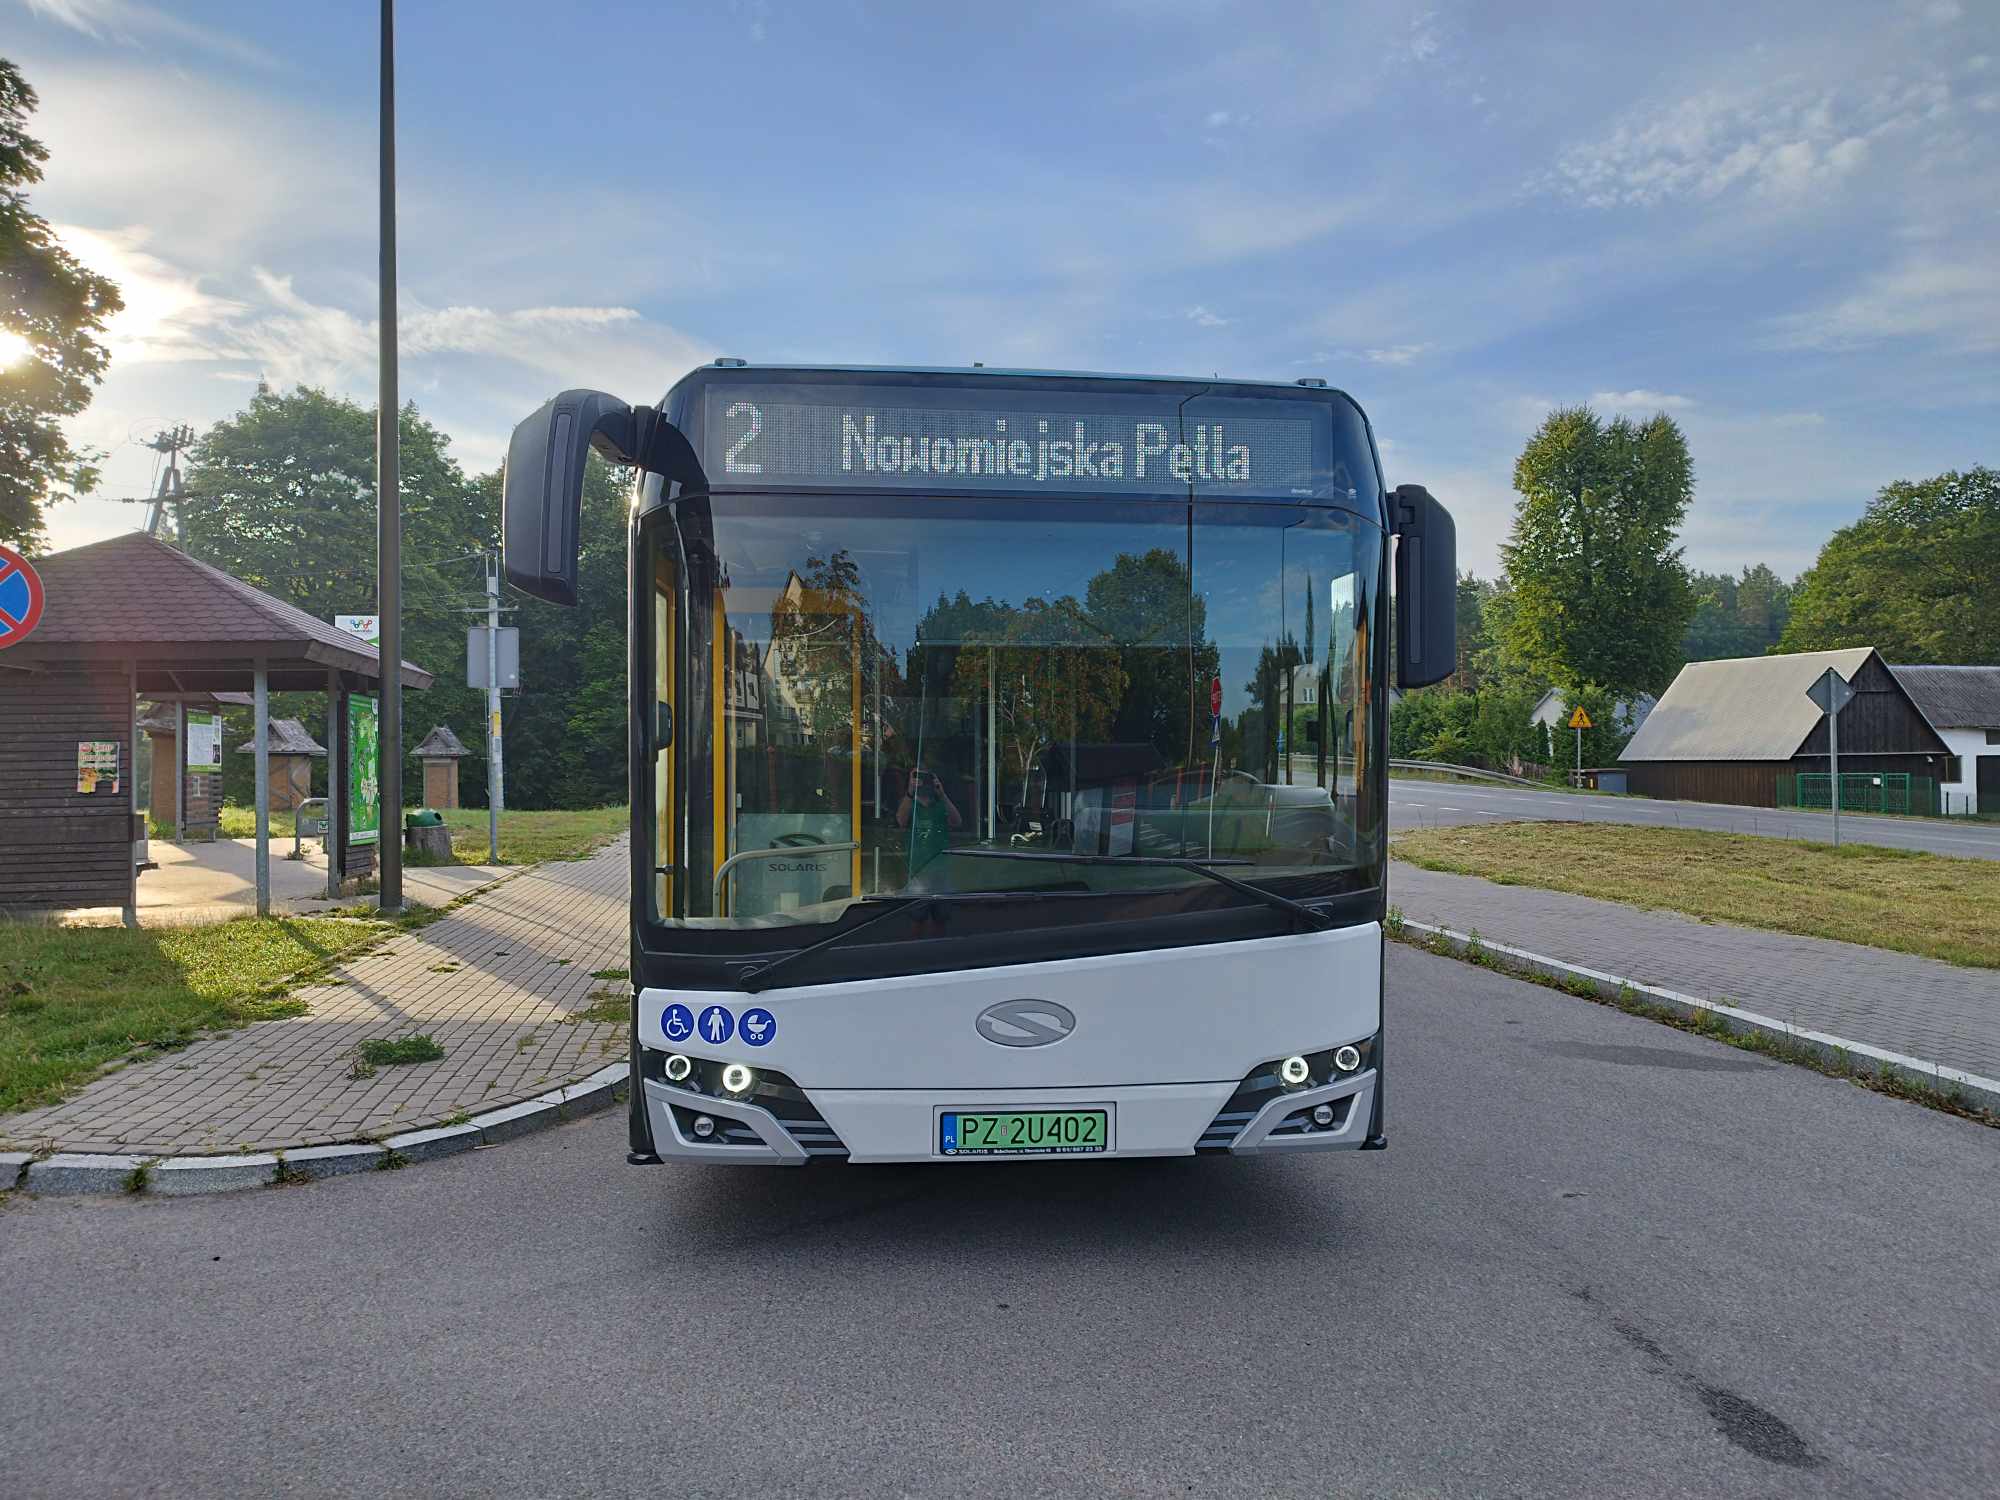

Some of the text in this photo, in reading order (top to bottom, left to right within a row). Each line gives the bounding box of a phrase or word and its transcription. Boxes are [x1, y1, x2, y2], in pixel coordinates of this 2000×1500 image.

[725, 402, 1250, 484] 2 Nowomiejska Pętla
[768, 863, 828, 871] SOLARIS
[962, 1116, 1097, 1145] PZ 2U402
